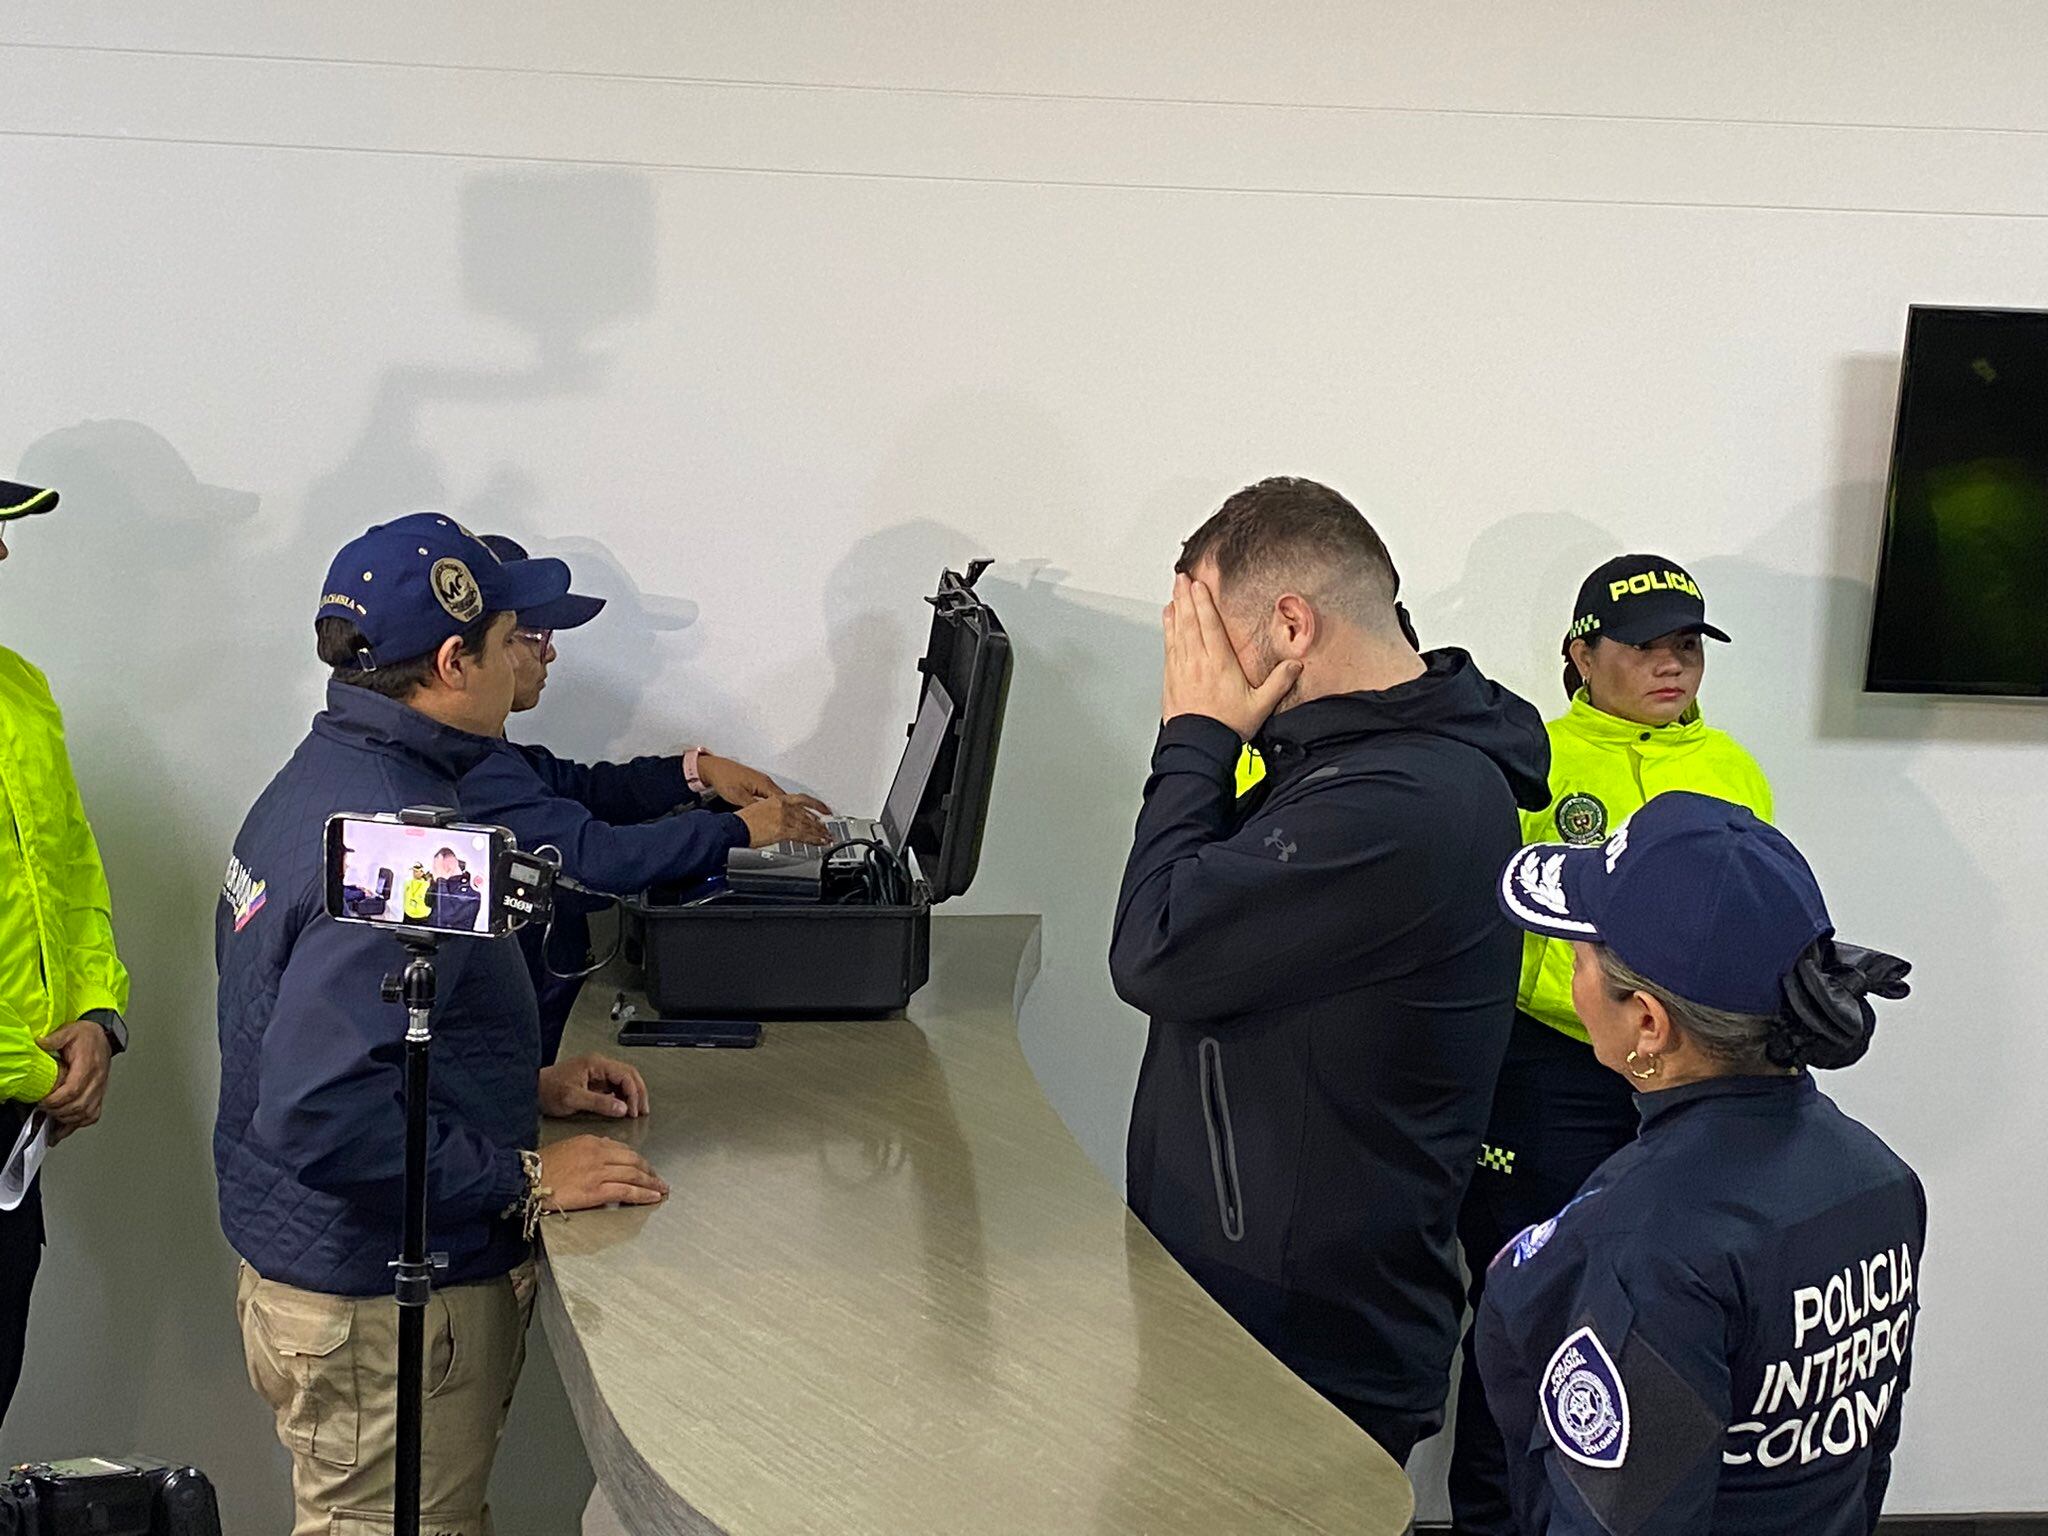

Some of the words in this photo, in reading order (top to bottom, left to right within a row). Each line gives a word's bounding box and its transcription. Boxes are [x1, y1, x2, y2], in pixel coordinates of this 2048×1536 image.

[1609, 571, 1702, 602] POLICIA
[1793, 1242, 1913, 1349] POLICIA
[1751, 1302, 1912, 1415] INTERPO
[1722, 1375, 1898, 1469] COLOM
